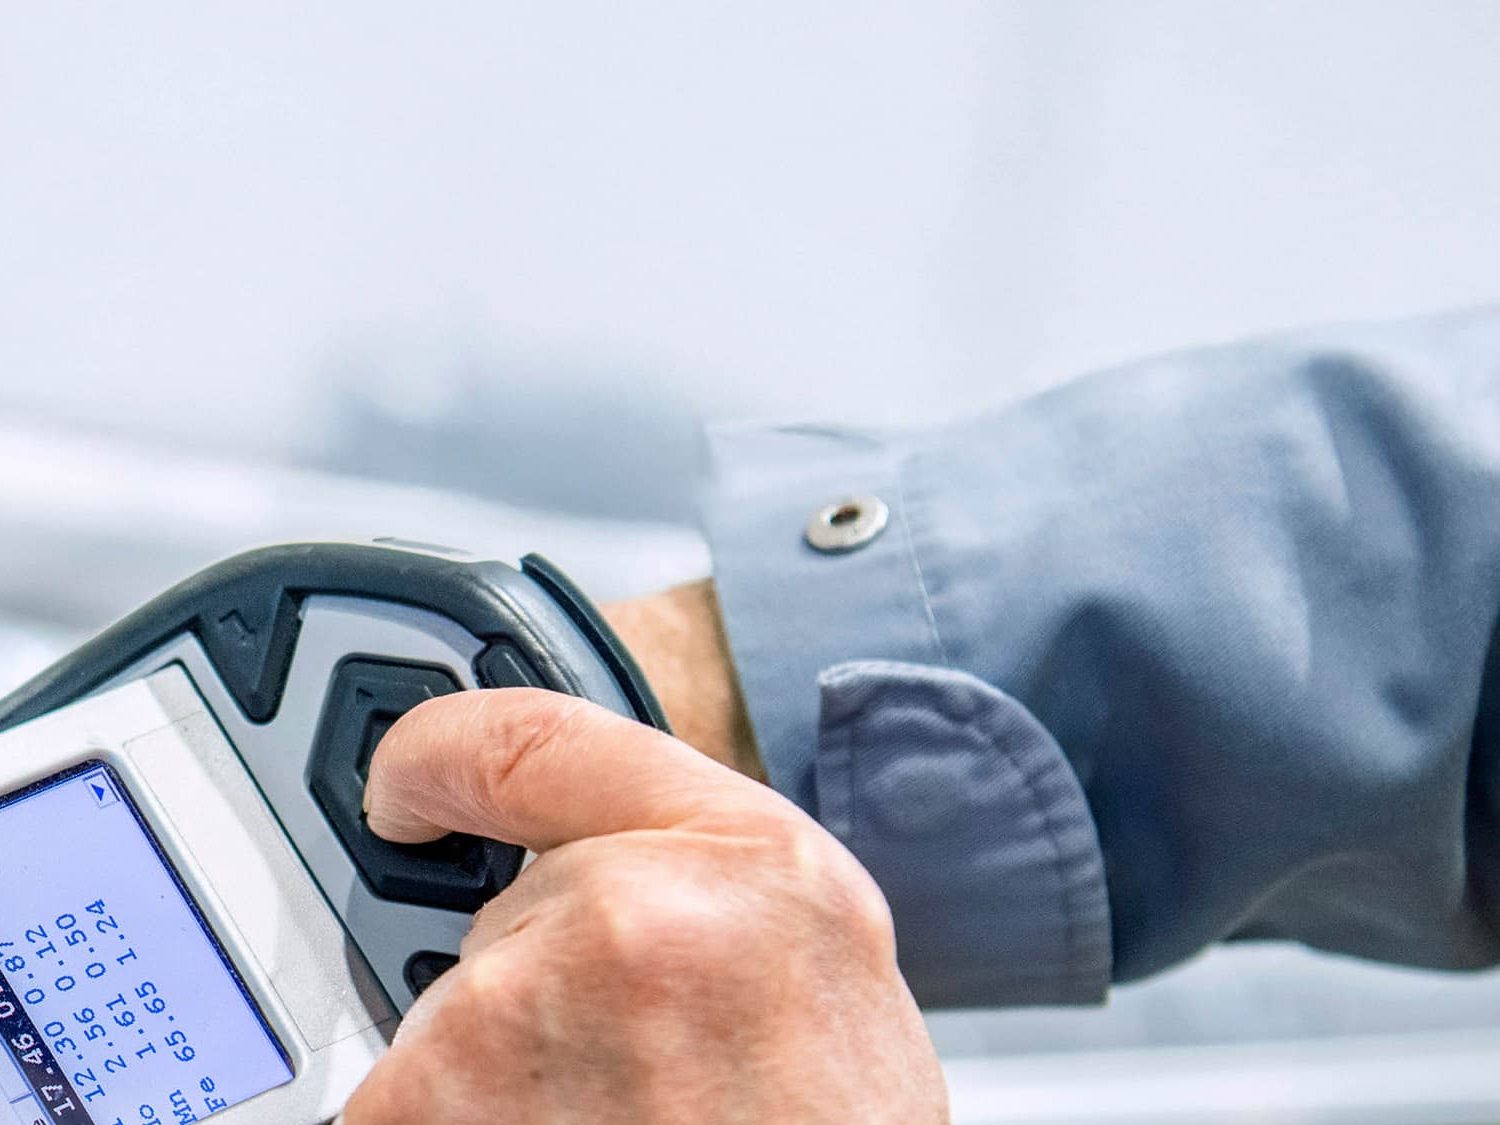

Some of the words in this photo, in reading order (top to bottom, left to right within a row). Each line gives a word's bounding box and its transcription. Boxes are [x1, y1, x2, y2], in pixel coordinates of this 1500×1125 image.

[24, 923, 76, 992] 0.12
[54, 912, 106, 979] 0.50
[84, 898, 138, 966] 1.24
[71, 1006, 127, 1074] 2.56
[104, 992, 157, 1059] 1.61
[133, 980, 196, 1062] 65.65
[10, 1032, 76, 1116] 17.46
[42, 1020, 106, 1103] 12.30
[198, 1075, 228, 1113] Fe
